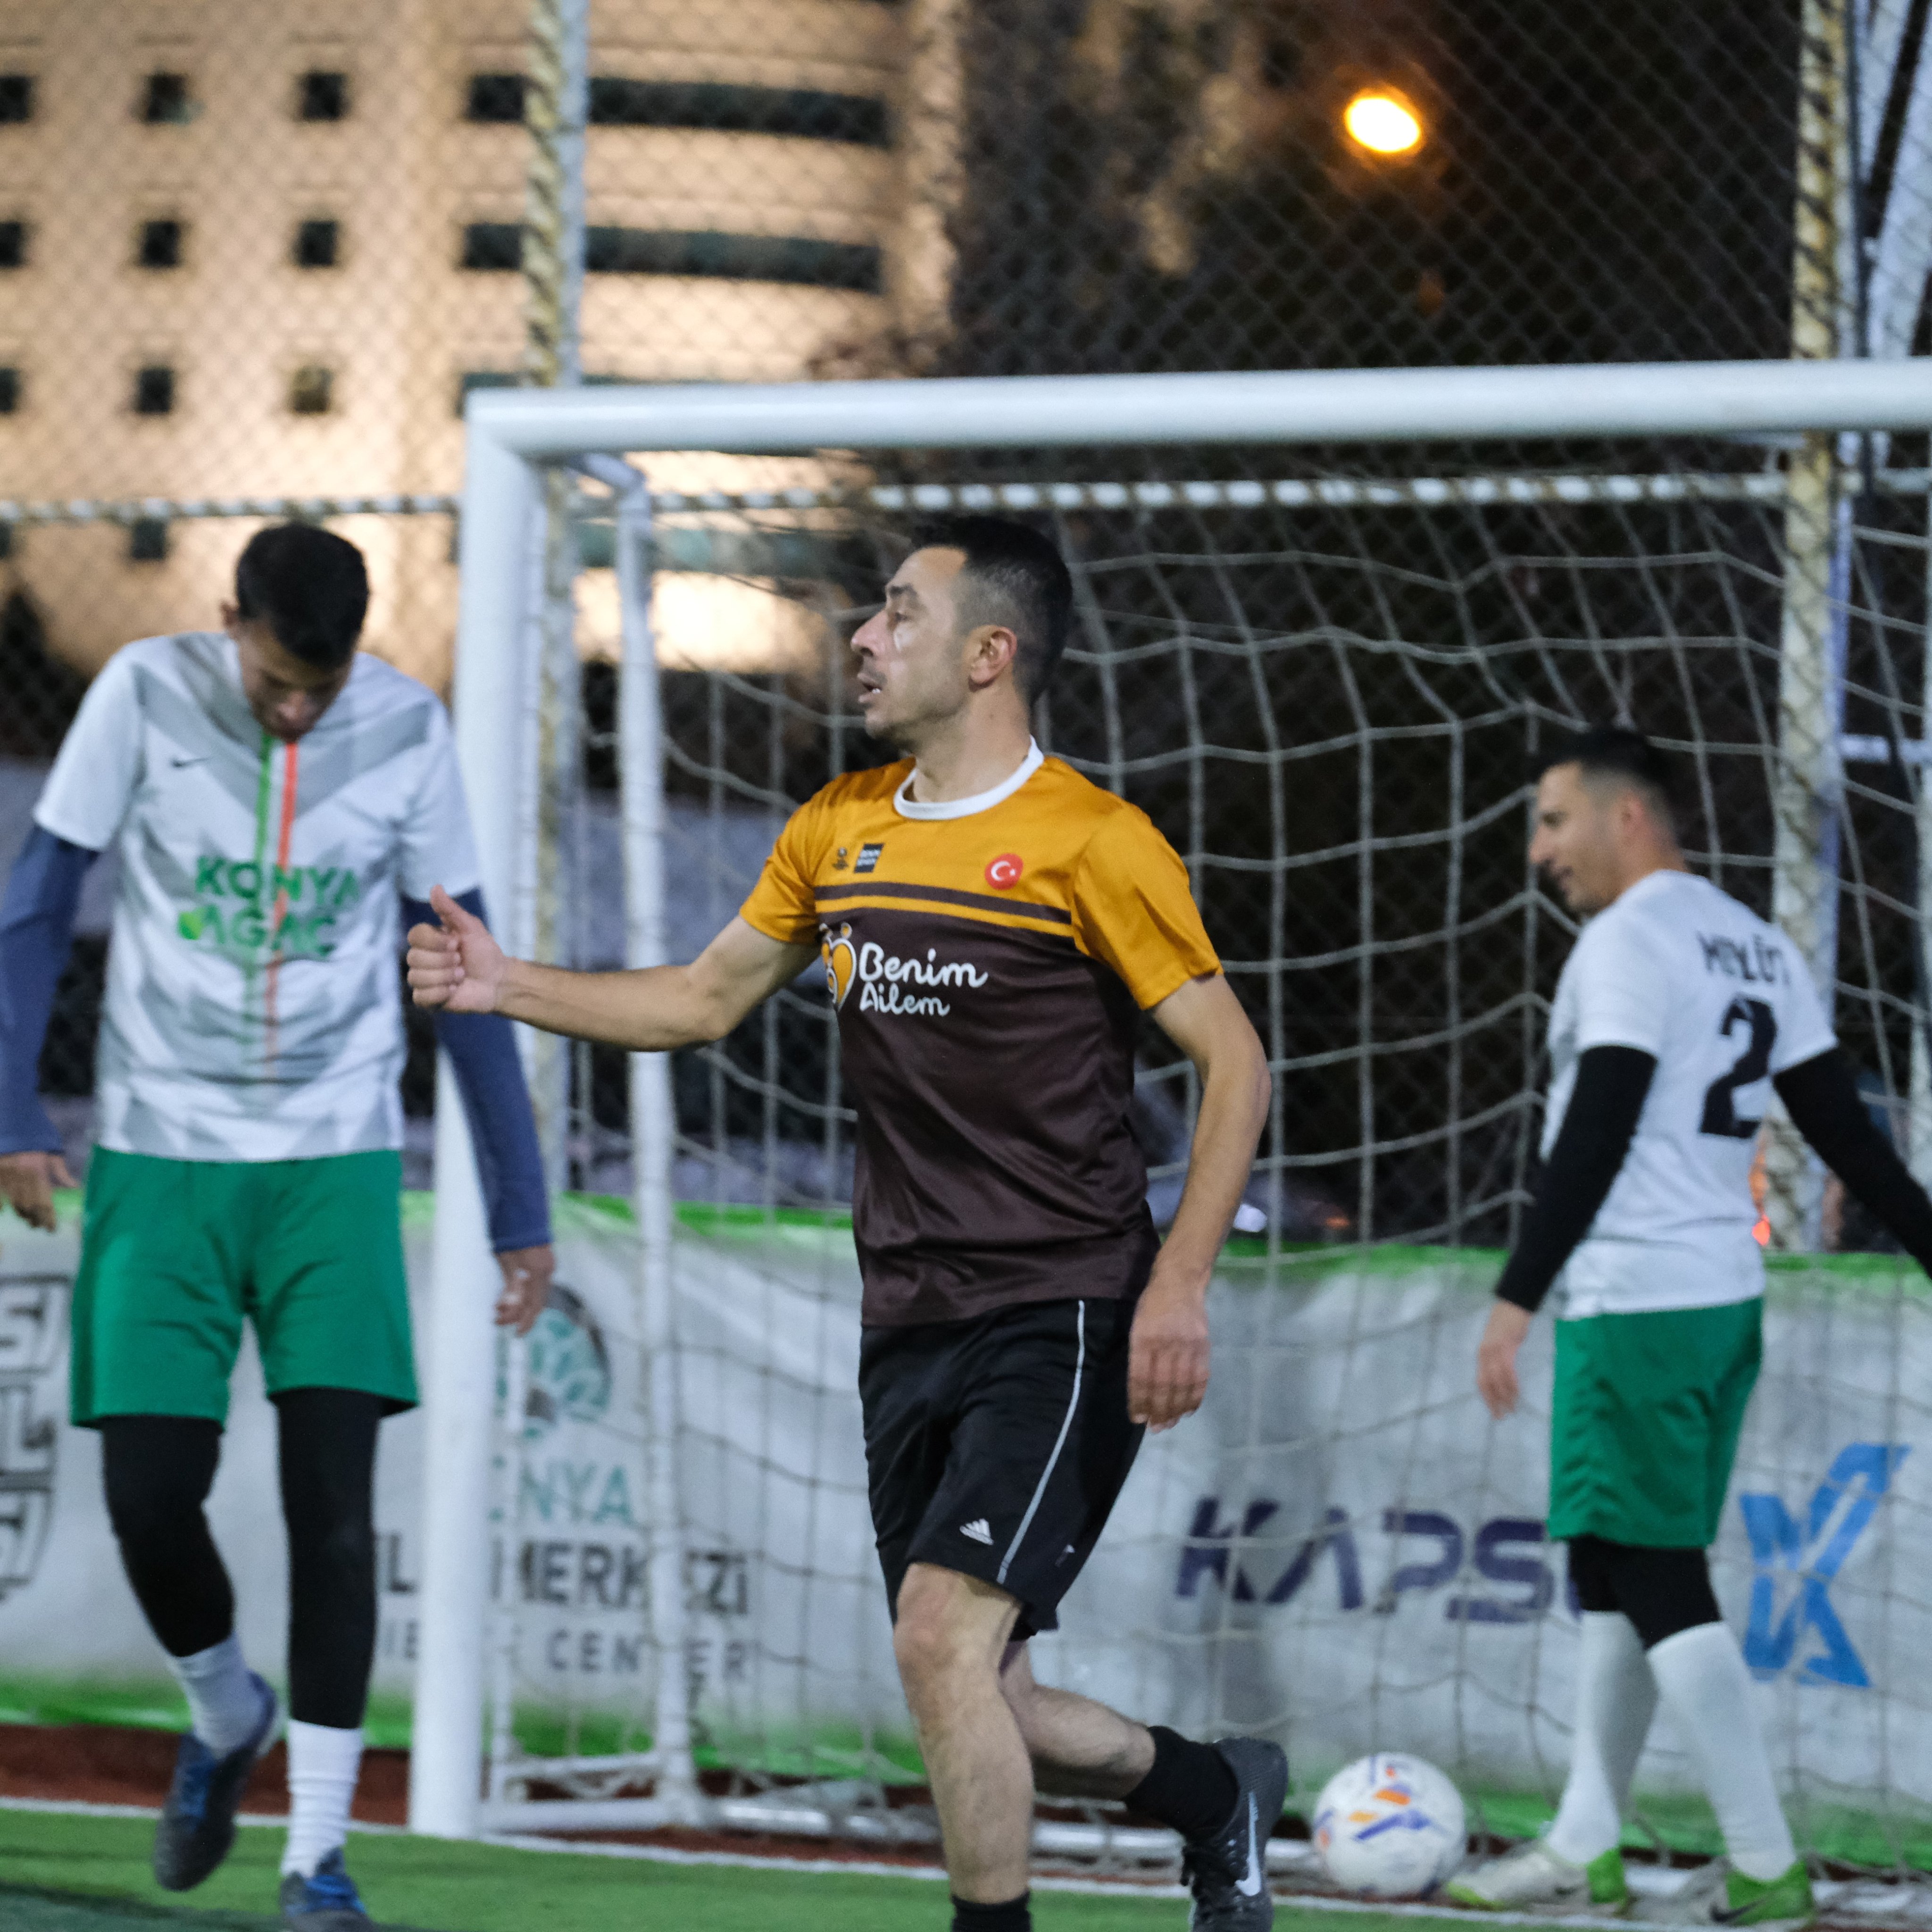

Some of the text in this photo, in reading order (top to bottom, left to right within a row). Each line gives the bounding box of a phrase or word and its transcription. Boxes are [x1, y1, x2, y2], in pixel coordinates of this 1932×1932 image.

[195, 855, 359, 907] KONYA
[858, 941, 988, 988] Benim
[859, 982, 950, 1017] Ailem
[1699, 992, 1776, 1139] 2
